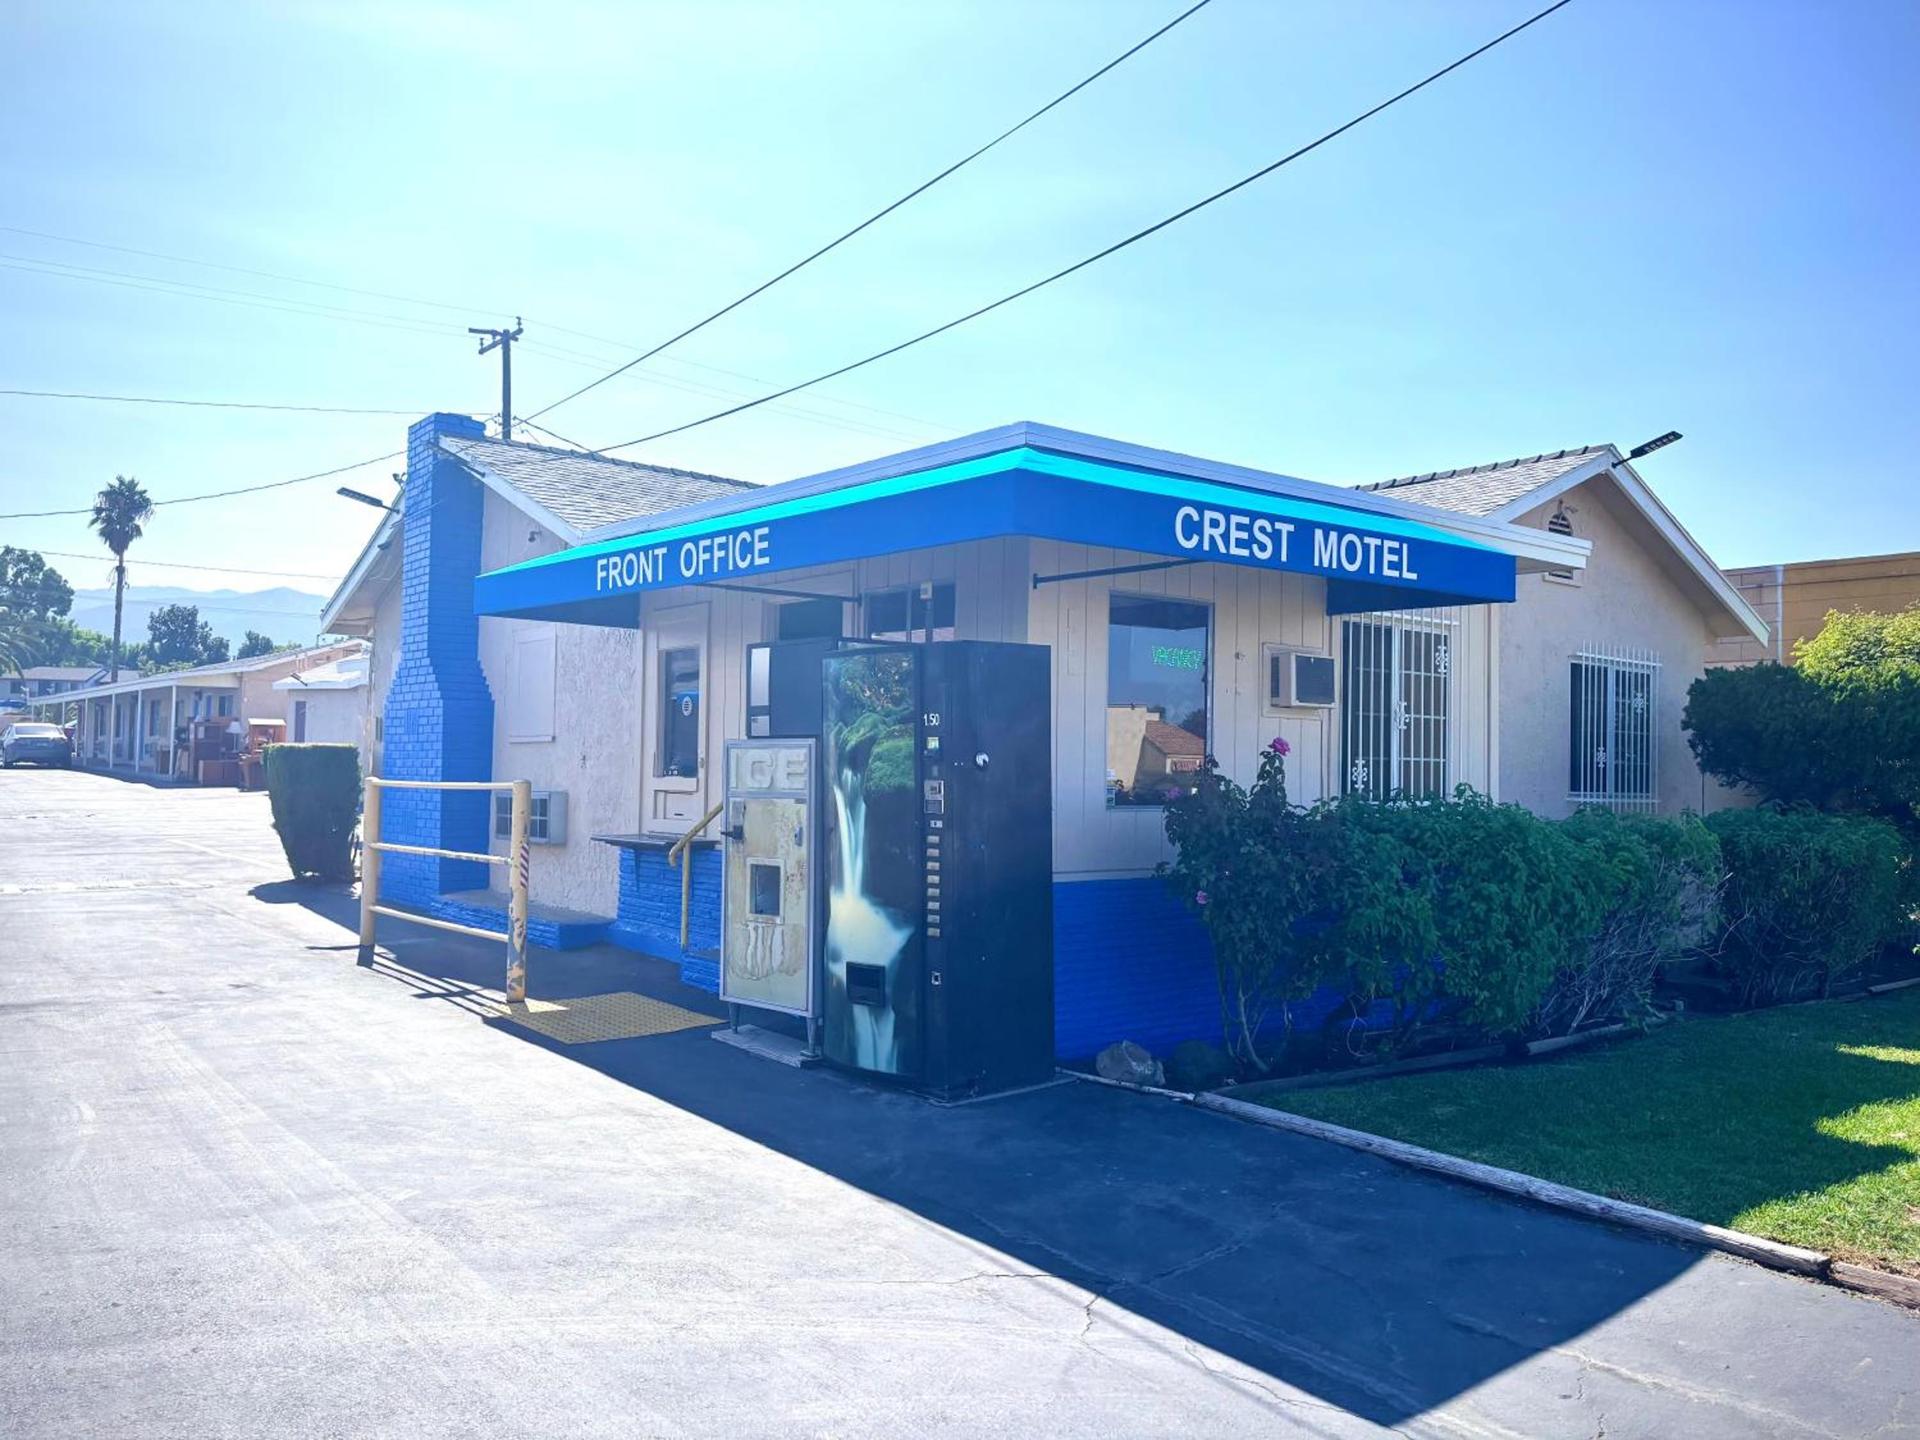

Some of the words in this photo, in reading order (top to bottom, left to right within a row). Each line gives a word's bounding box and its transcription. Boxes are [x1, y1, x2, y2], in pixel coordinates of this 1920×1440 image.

[596, 547, 667, 591] FRONT
[680, 527, 770, 578] OFFICE
[1175, 506, 1294, 562] CREST
[1314, 528, 1418, 580] MOTEL
[730, 749, 808, 790] ICE
